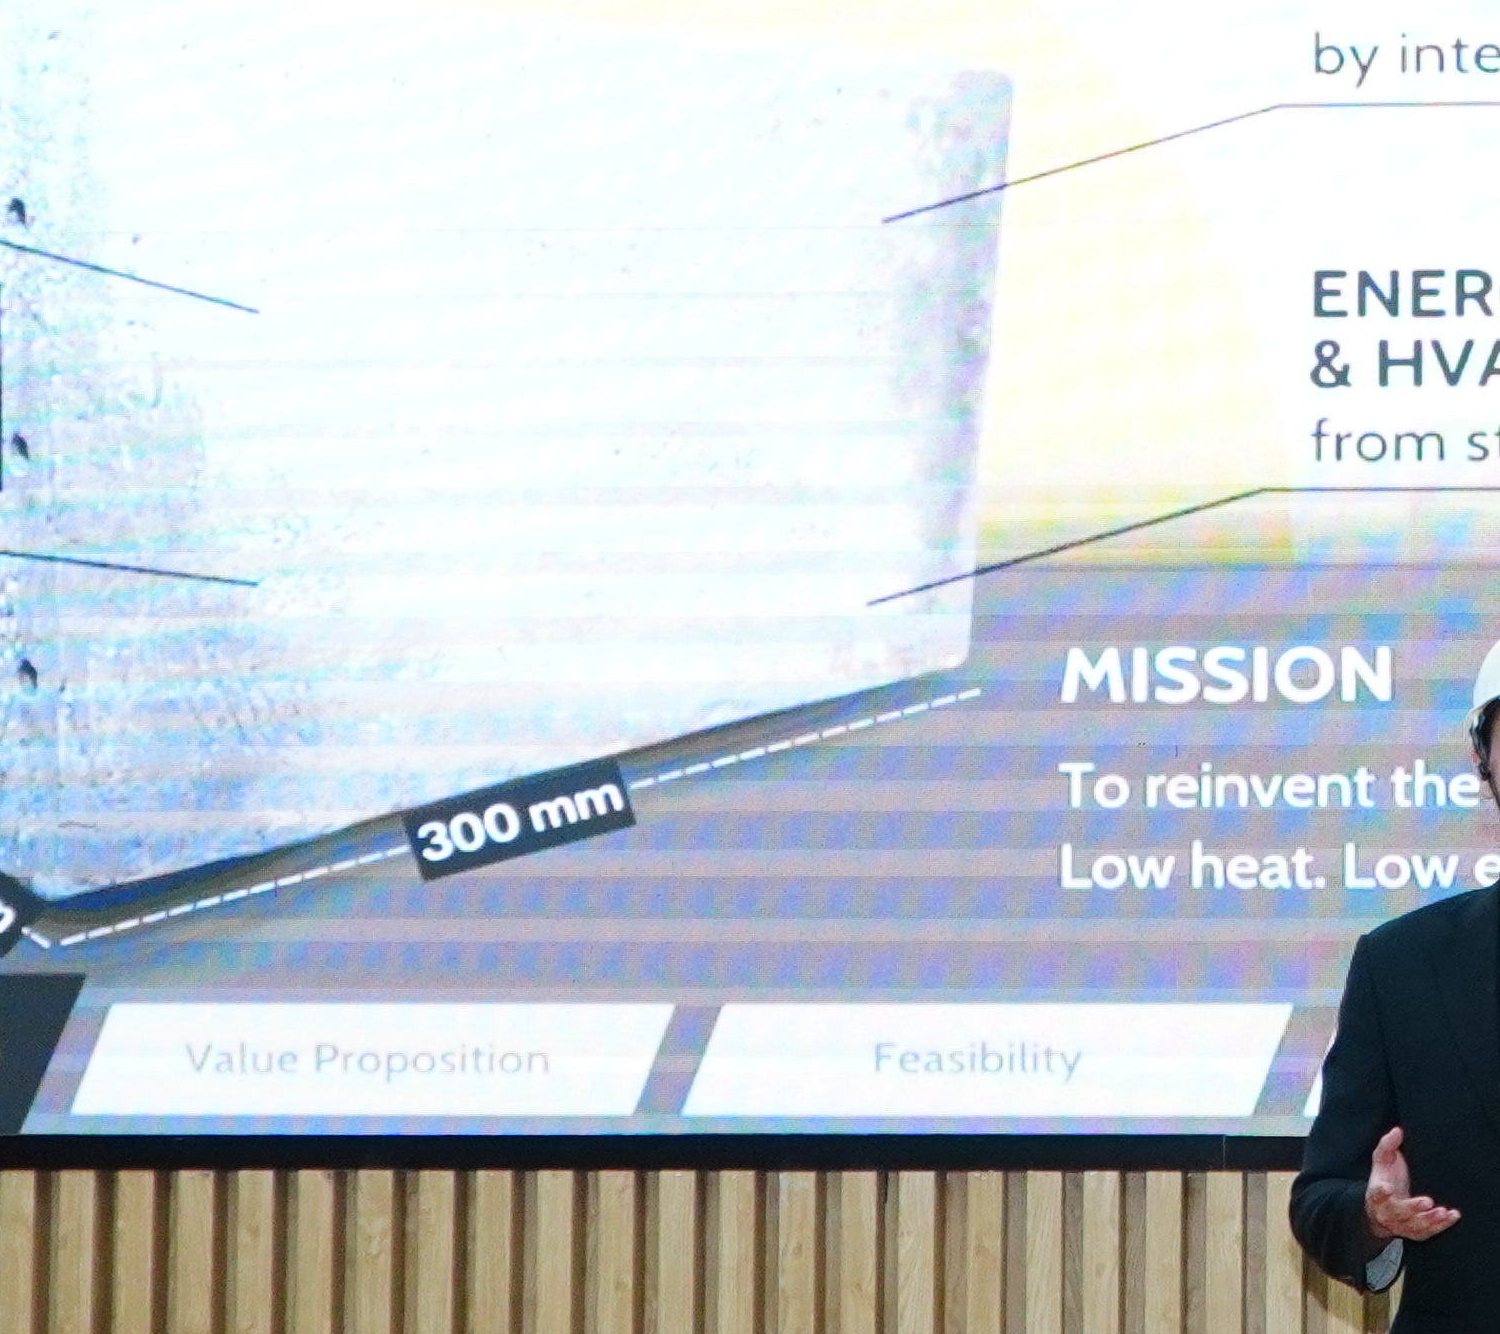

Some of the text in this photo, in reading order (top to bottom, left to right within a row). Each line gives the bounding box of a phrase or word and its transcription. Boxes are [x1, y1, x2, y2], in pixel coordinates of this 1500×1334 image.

[1315, 32, 1378, 87] by
[1310, 340, 1351, 388] &
[1311, 418, 1444, 462] from
[1061, 646, 1391, 704] MISSION
[1059, 759, 1480, 808] To reinvent the
[417, 779, 625, 863] 300 mm
[1062, 840, 1459, 889] Low heat. Low
[186, 1041, 551, 1082] Value Proposition
[873, 1041, 1083, 1082] Feasibility
